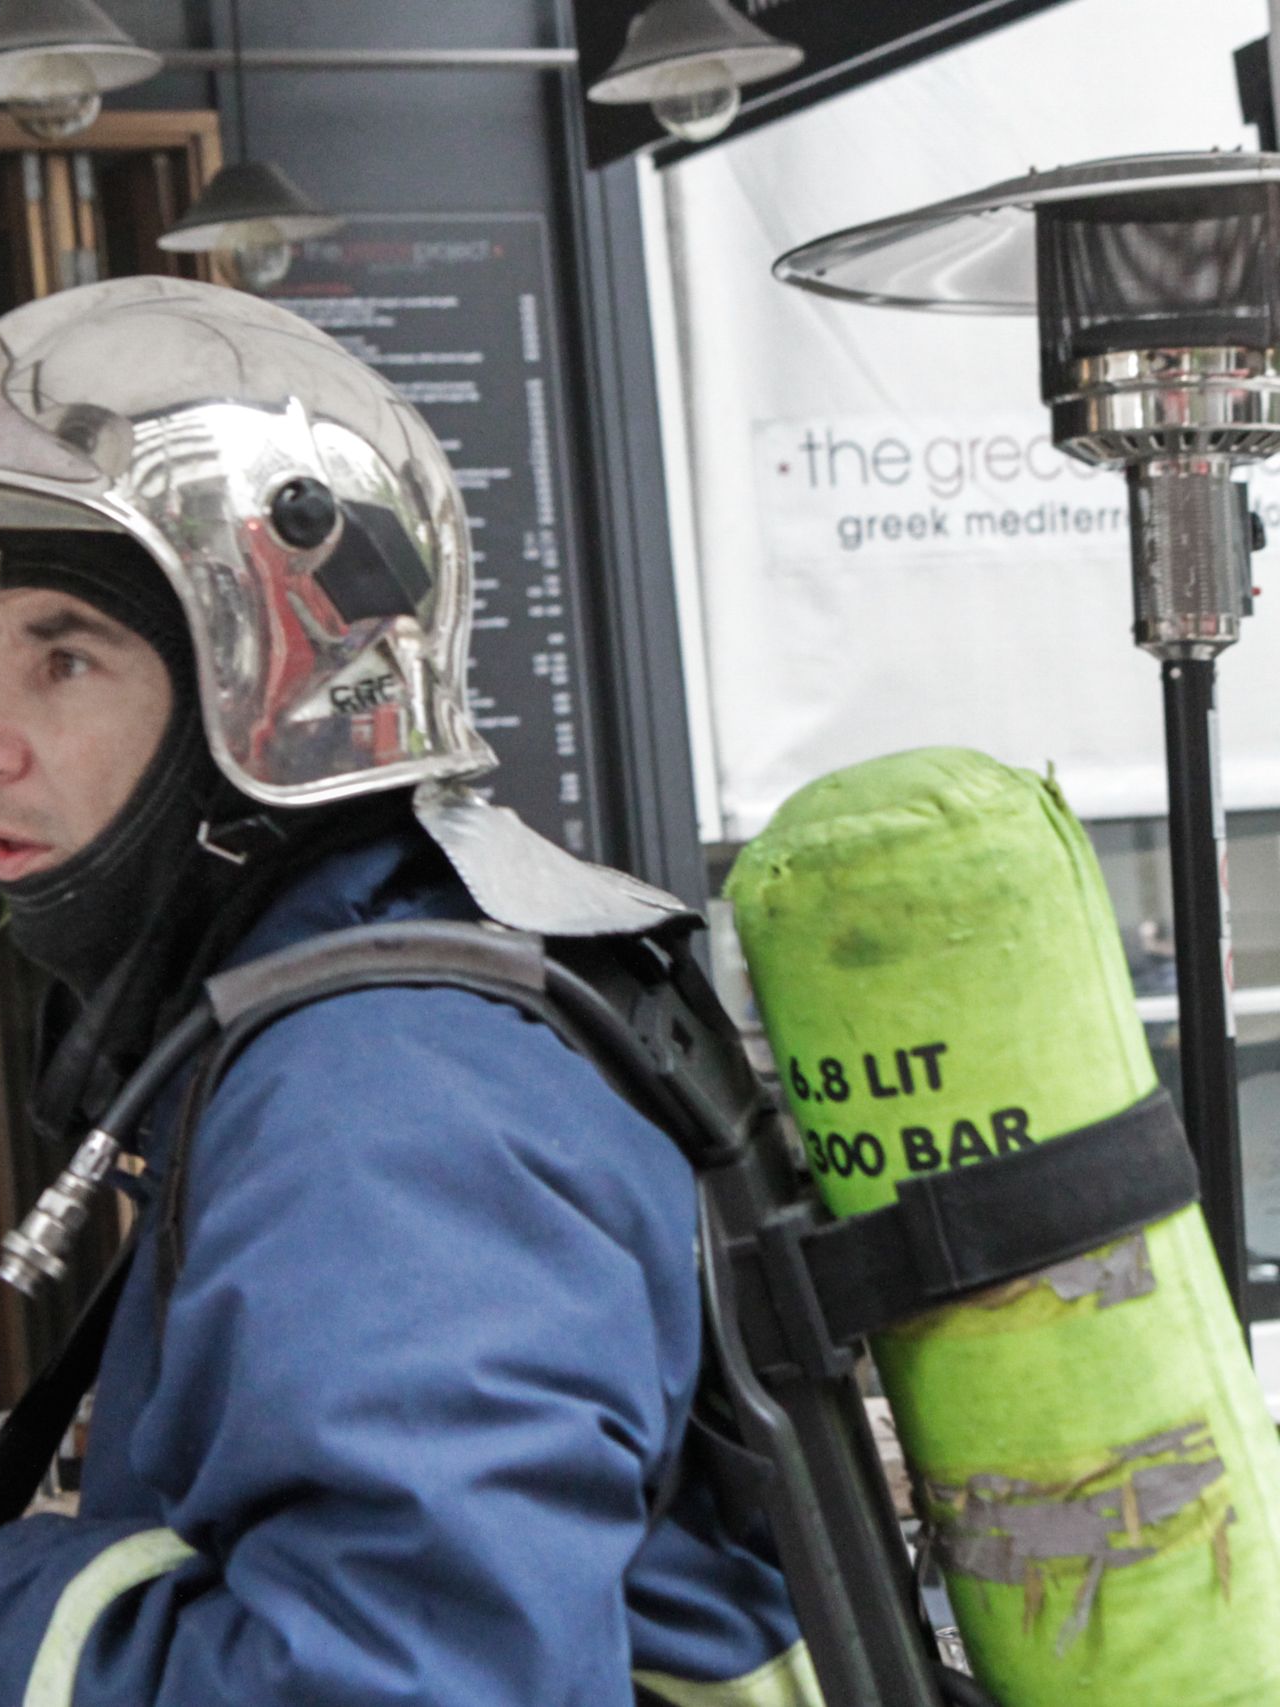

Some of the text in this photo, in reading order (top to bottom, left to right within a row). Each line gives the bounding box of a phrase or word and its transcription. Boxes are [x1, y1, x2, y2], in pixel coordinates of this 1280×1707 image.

[799, 429, 912, 488] the
[837, 502, 1130, 550] greek mediterr
[788, 1041, 948, 1105] 6.8 LIT
[805, 1106, 1039, 1178] 300 BAR
